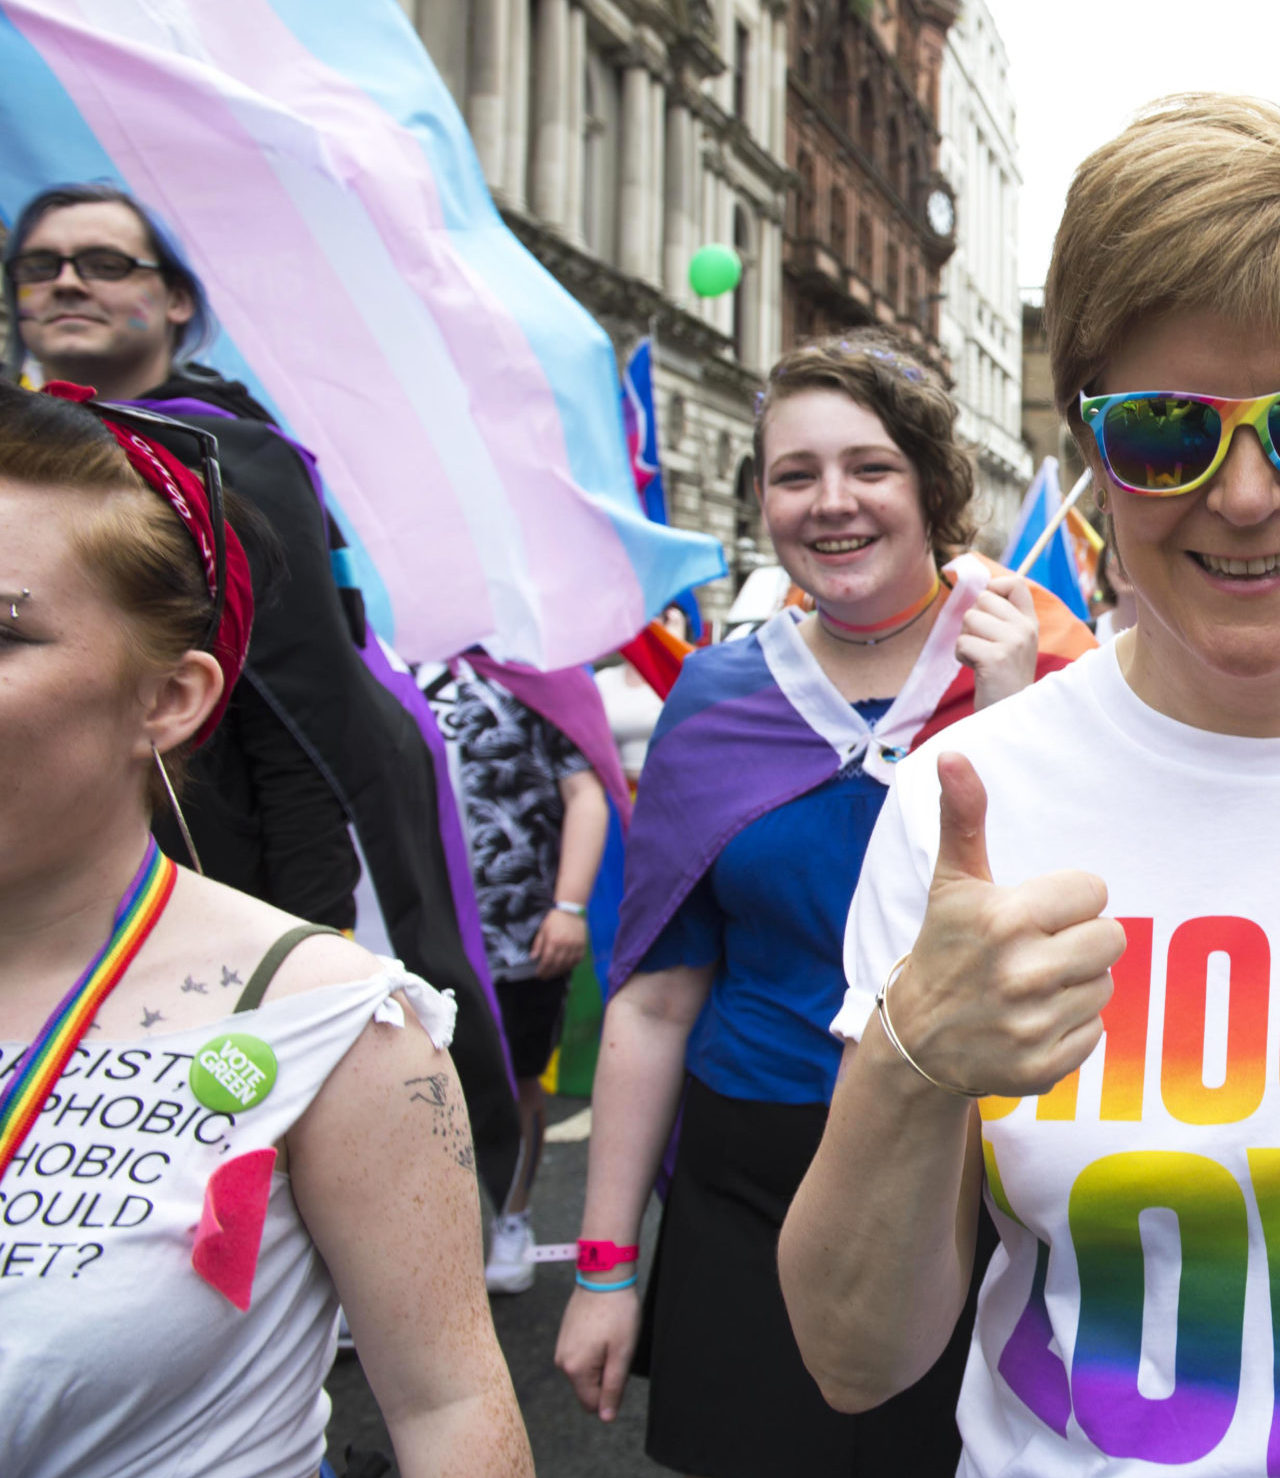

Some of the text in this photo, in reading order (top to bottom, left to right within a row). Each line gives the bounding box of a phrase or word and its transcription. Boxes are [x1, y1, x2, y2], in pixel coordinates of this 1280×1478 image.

[199, 1050, 258, 1106] GREEN
[219, 1038, 267, 1090] VOTE
[0, 1190, 154, 1228] OULD
[0, 1242, 104, 1278] ET?
